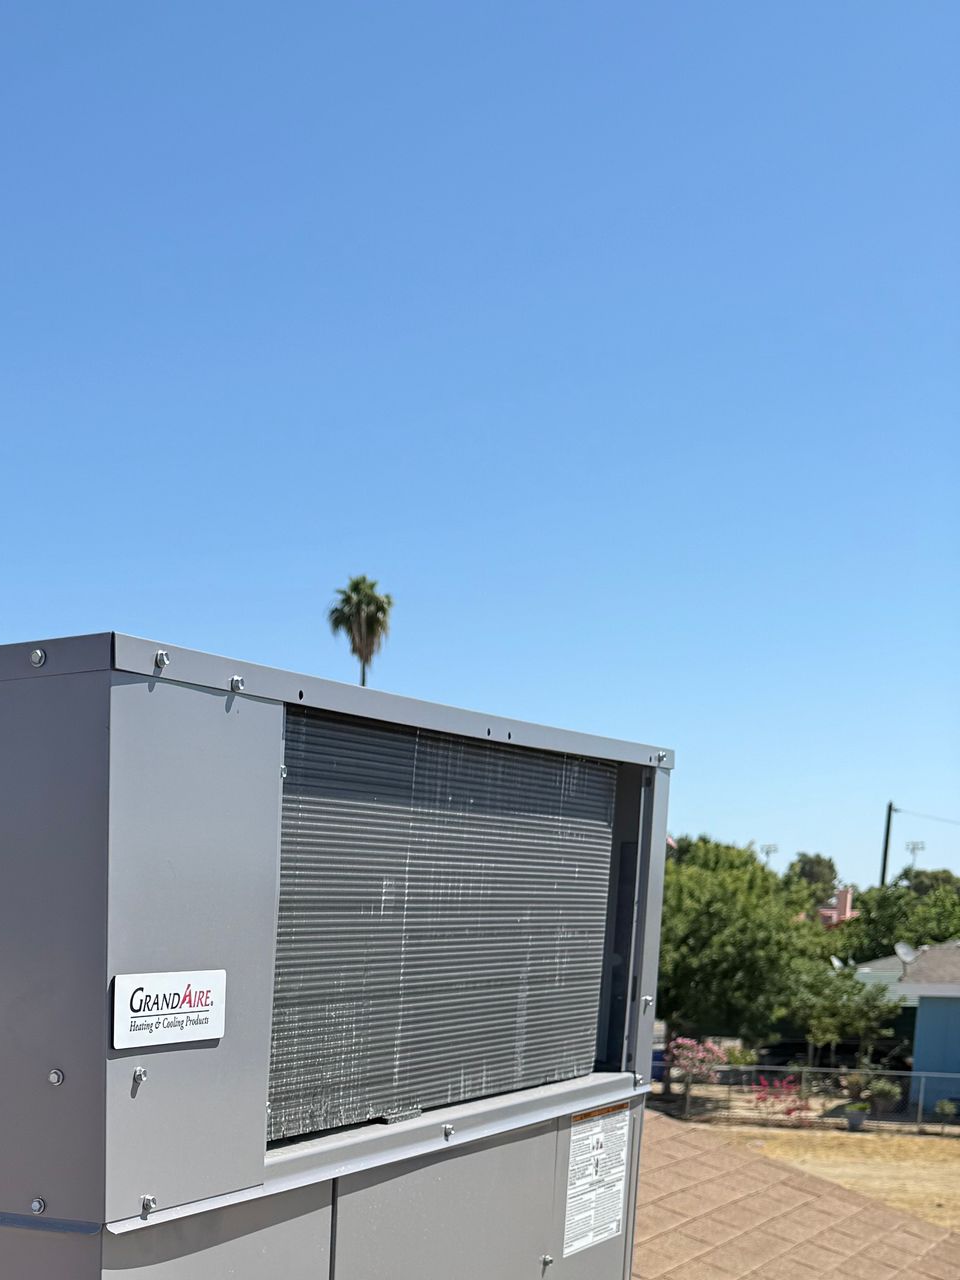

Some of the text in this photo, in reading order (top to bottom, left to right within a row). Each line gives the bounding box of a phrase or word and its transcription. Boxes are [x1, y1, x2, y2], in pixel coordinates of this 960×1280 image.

[129, 1014, 209, 1033] Heating & Cooling Products
